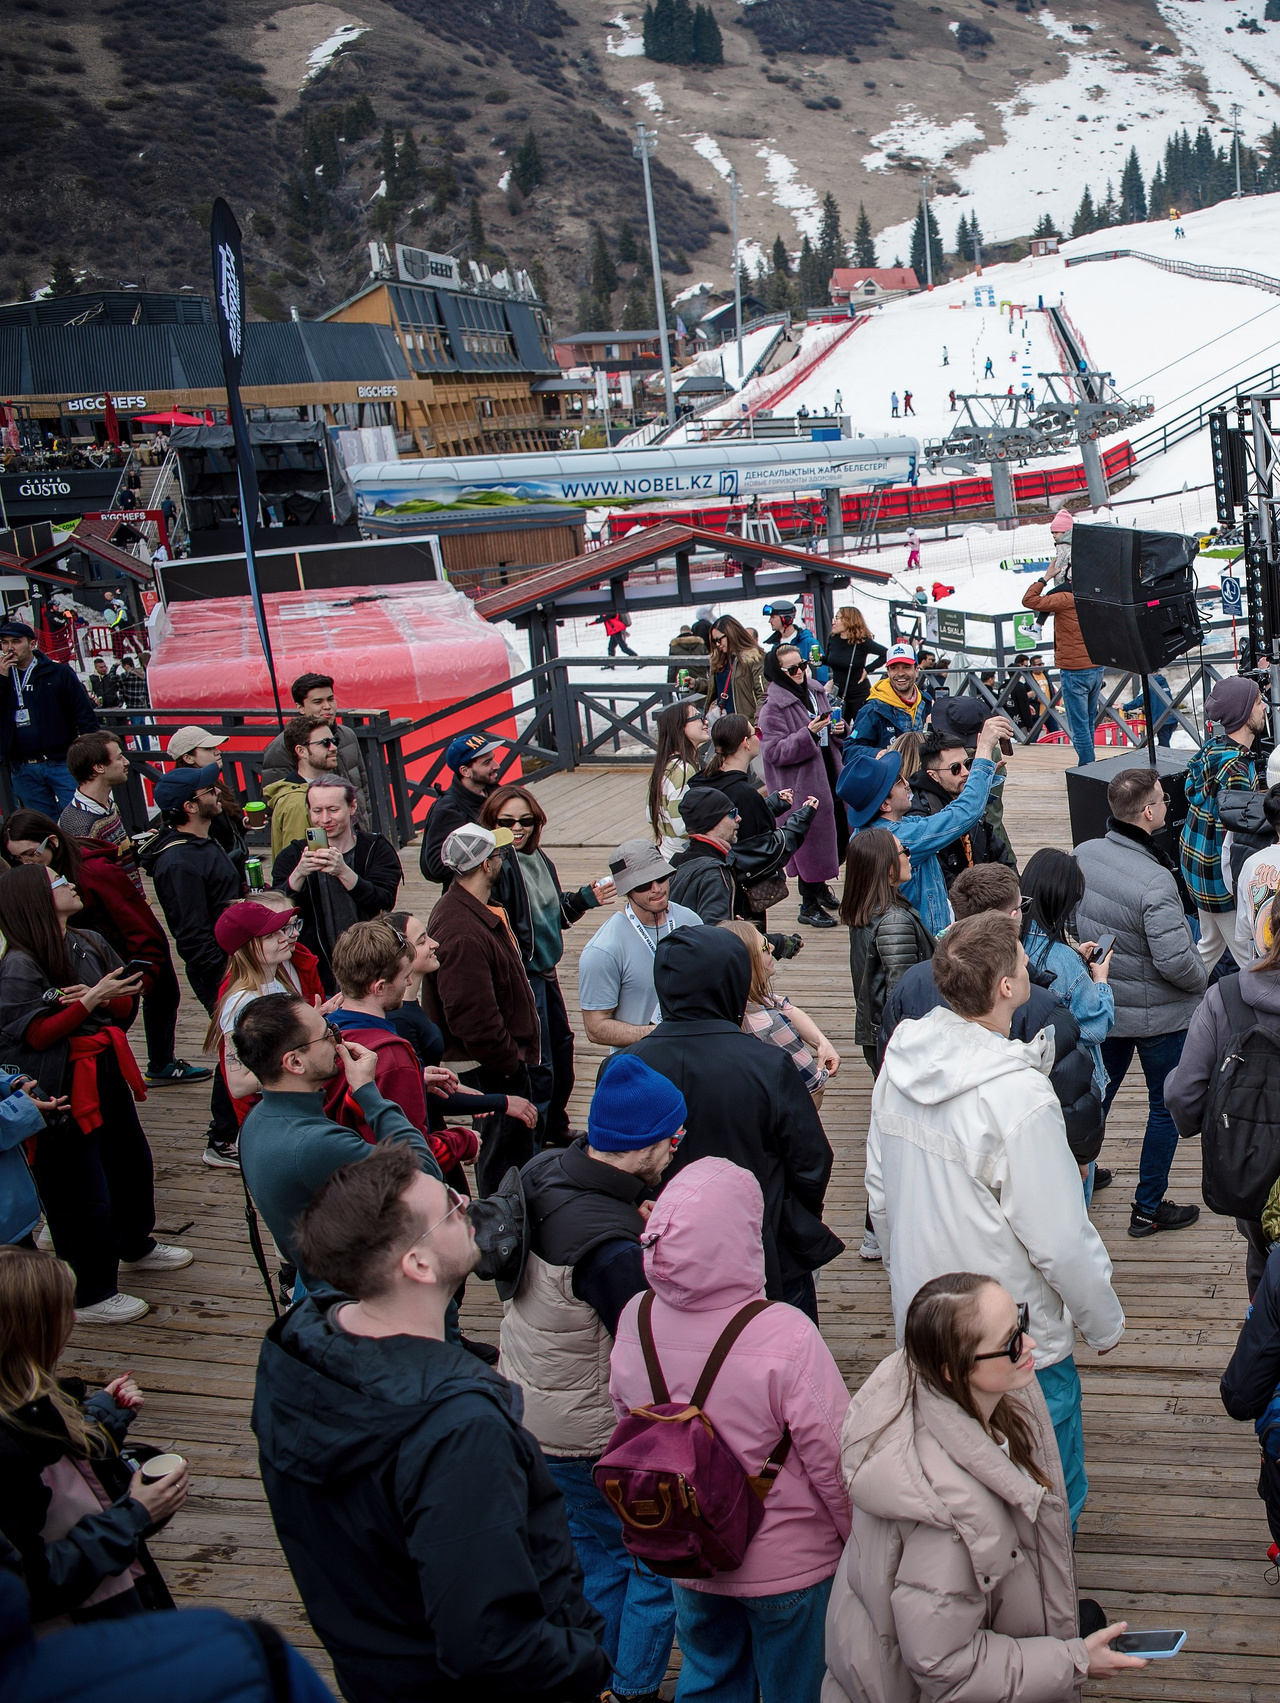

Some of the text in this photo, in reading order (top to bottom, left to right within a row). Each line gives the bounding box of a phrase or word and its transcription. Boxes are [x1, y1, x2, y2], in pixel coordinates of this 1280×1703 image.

[358, 386, 398, 398] BIGCHEFS
[19, 482, 71, 497] GUSTO
[561, 475, 713, 498] WWW.NOBEL.KZ
[940, 625, 965, 637] LA SKALA
